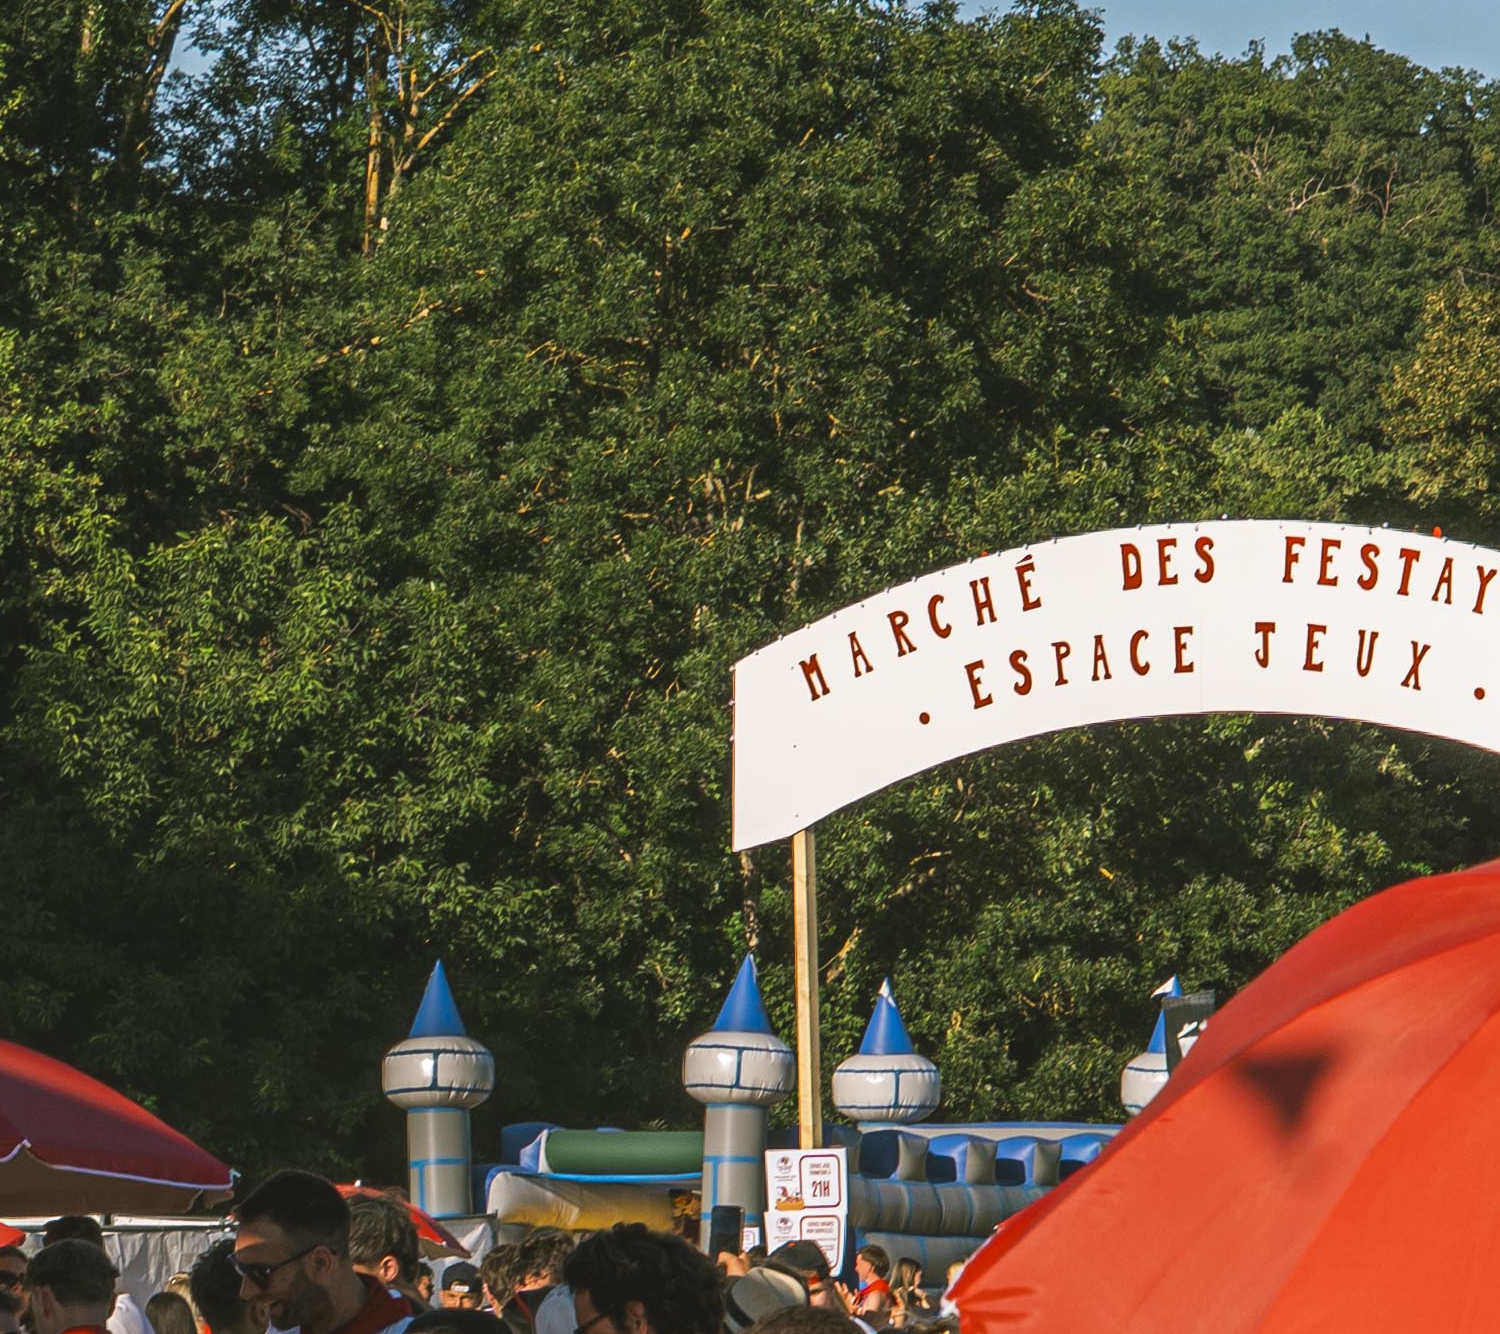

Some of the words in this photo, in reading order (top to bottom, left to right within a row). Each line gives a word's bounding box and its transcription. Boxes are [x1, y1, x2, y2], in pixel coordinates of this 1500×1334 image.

[798, 554, 1042, 702] MARCHÉ
[1119, 536, 1215, 591] DES
[964, 625, 1194, 710] ESPACE
[1254, 621, 1431, 691] JEUX
[812, 1180, 830, 1197] 21H
